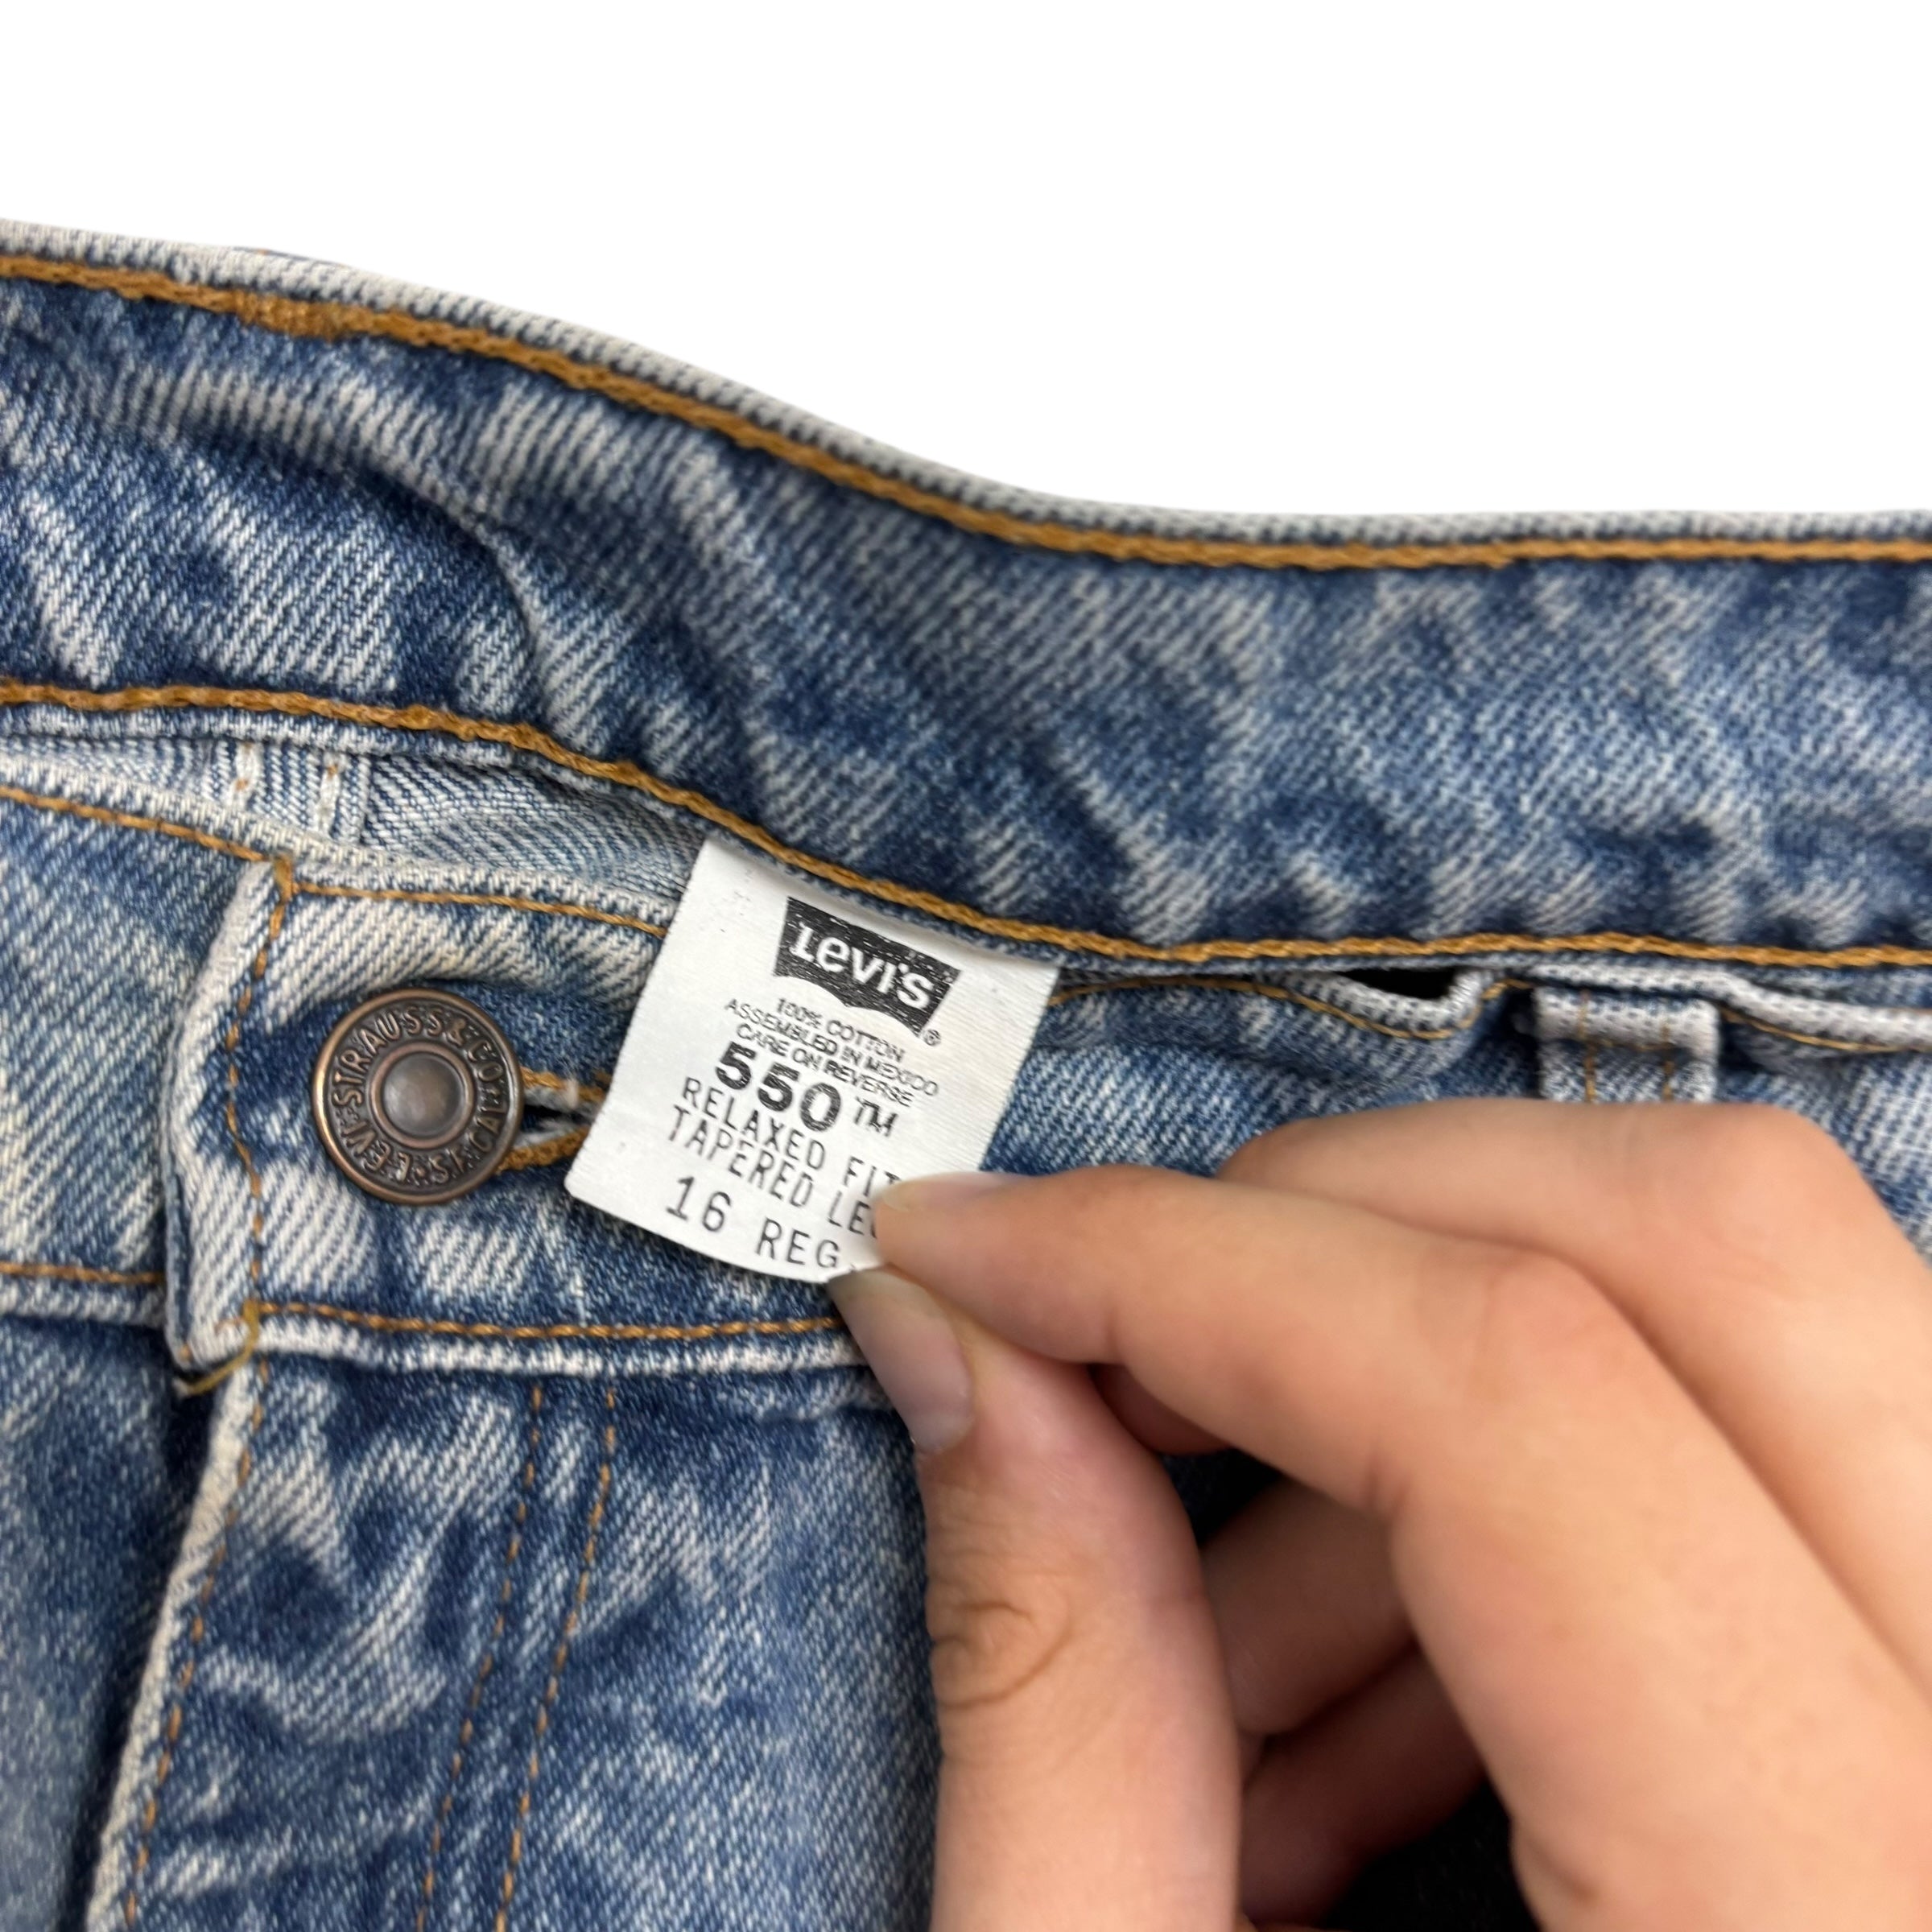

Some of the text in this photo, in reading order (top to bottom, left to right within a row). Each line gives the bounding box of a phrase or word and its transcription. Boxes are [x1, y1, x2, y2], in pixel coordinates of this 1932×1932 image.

[332, 1006, 444, 1106] STRAUSS
[724, 998, 939, 1096] ASSEMBLED IN MEXICO
[736, 1022, 915, 1108] CARE ON REVERSE
[776, 997, 906, 1063] 100% COTTON
[682, 1076, 826, 1170] RELAXED
[666, 1175, 733, 1232] 16
[668, 1104, 877, 1240] TAPERED LE
